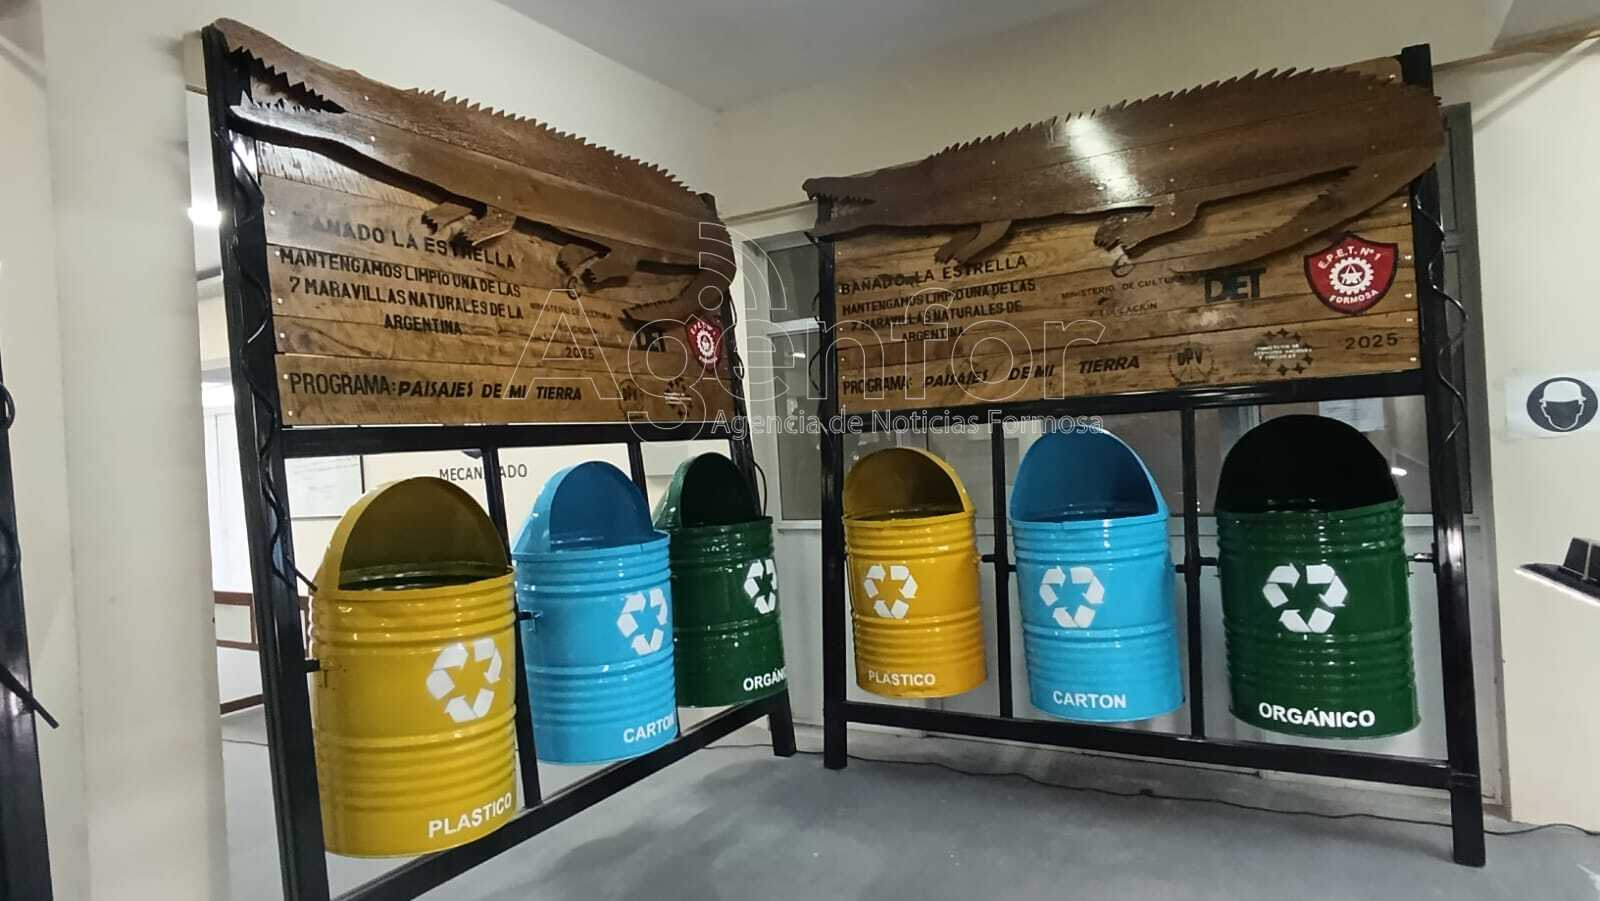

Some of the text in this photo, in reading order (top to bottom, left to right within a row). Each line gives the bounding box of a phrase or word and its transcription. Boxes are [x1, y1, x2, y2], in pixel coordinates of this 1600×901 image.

[391, 229, 419, 251] LA
[279, 247, 521, 298] MANTENGAMOS LIMPIO UNA DE LAS
[943, 255, 1028, 280] ESTRELLA
[842, 295, 924, 316] MANTENGAMOS
[965, 284, 991, 299] UNA
[992, 281, 1009, 296] DE
[1010, 279, 1037, 294] LAS
[1203, 267, 1266, 305] DET
[1328, 288, 1380, 305] FORMOSA
[304, 277, 406, 305] MARAVILLAS
[408, 289, 488, 316] NATURALES
[490, 302, 506, 318] DE
[507, 304, 524, 320] LA
[933, 301, 1005, 322] NATURALES
[1006, 299, 1024, 313] DE
[384, 313, 463, 336] ARGENTINA
[1344, 332, 1399, 351] 2025
[1008, 366, 1031, 381] DE
[1033, 364, 1055, 379] MI
[1079, 356, 1140, 374] TIERRA
[397, 380, 474, 398] PAISAJES
[481, 383, 502, 399] DE
[508, 384, 527, 399] MI
[536, 386, 582, 401] TIERRA
[1052, 690, 1127, 709] CARTON
[427, 791, 513, 839] PLASTICO
